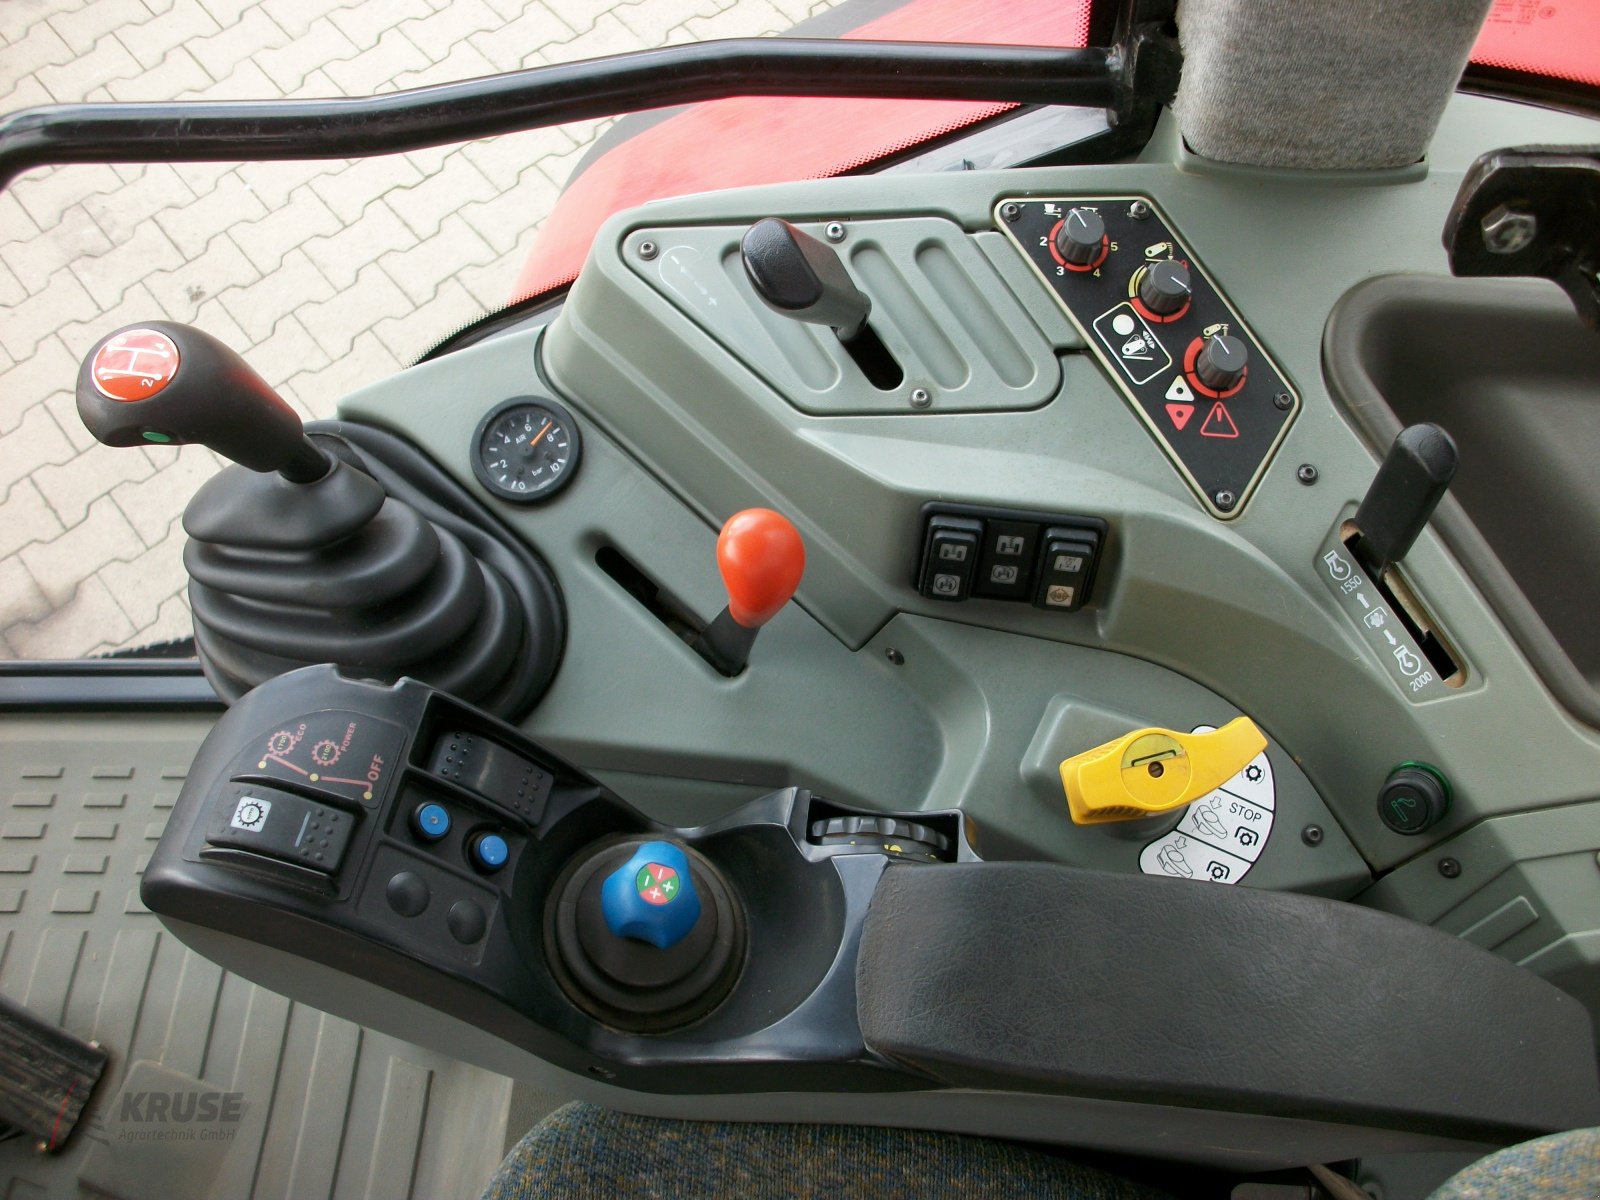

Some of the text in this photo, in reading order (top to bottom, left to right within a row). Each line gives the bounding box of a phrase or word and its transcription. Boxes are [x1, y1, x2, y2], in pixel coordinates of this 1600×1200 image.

[1040, 237, 1048, 247] 2
[1110, 242, 1119, 251] 5
[1056, 266, 1064, 276] 3
[1093, 268, 1101, 278] 4
[141, 378, 154, 388] 2
[524, 423, 532, 432] 6
[504, 435, 511, 444] 4
[515, 433, 527, 445] AIR
[546, 433, 554, 442] 8
[499, 459, 508, 469] 2
[549, 462, 560, 473] 10
[531, 466, 543, 477] bar
[518, 481, 526, 490] 0
[1340, 574, 1362, 595] 1550
[1409, 671, 1433, 692] 2000
[295, 723, 307, 742] ECO
[340, 722, 357, 752] POWER
[277, 735, 287, 751] 1700
[321, 744, 332, 761] 2100
[367, 754, 384, 782] OFF
[1229, 802, 1262, 822] STOP
